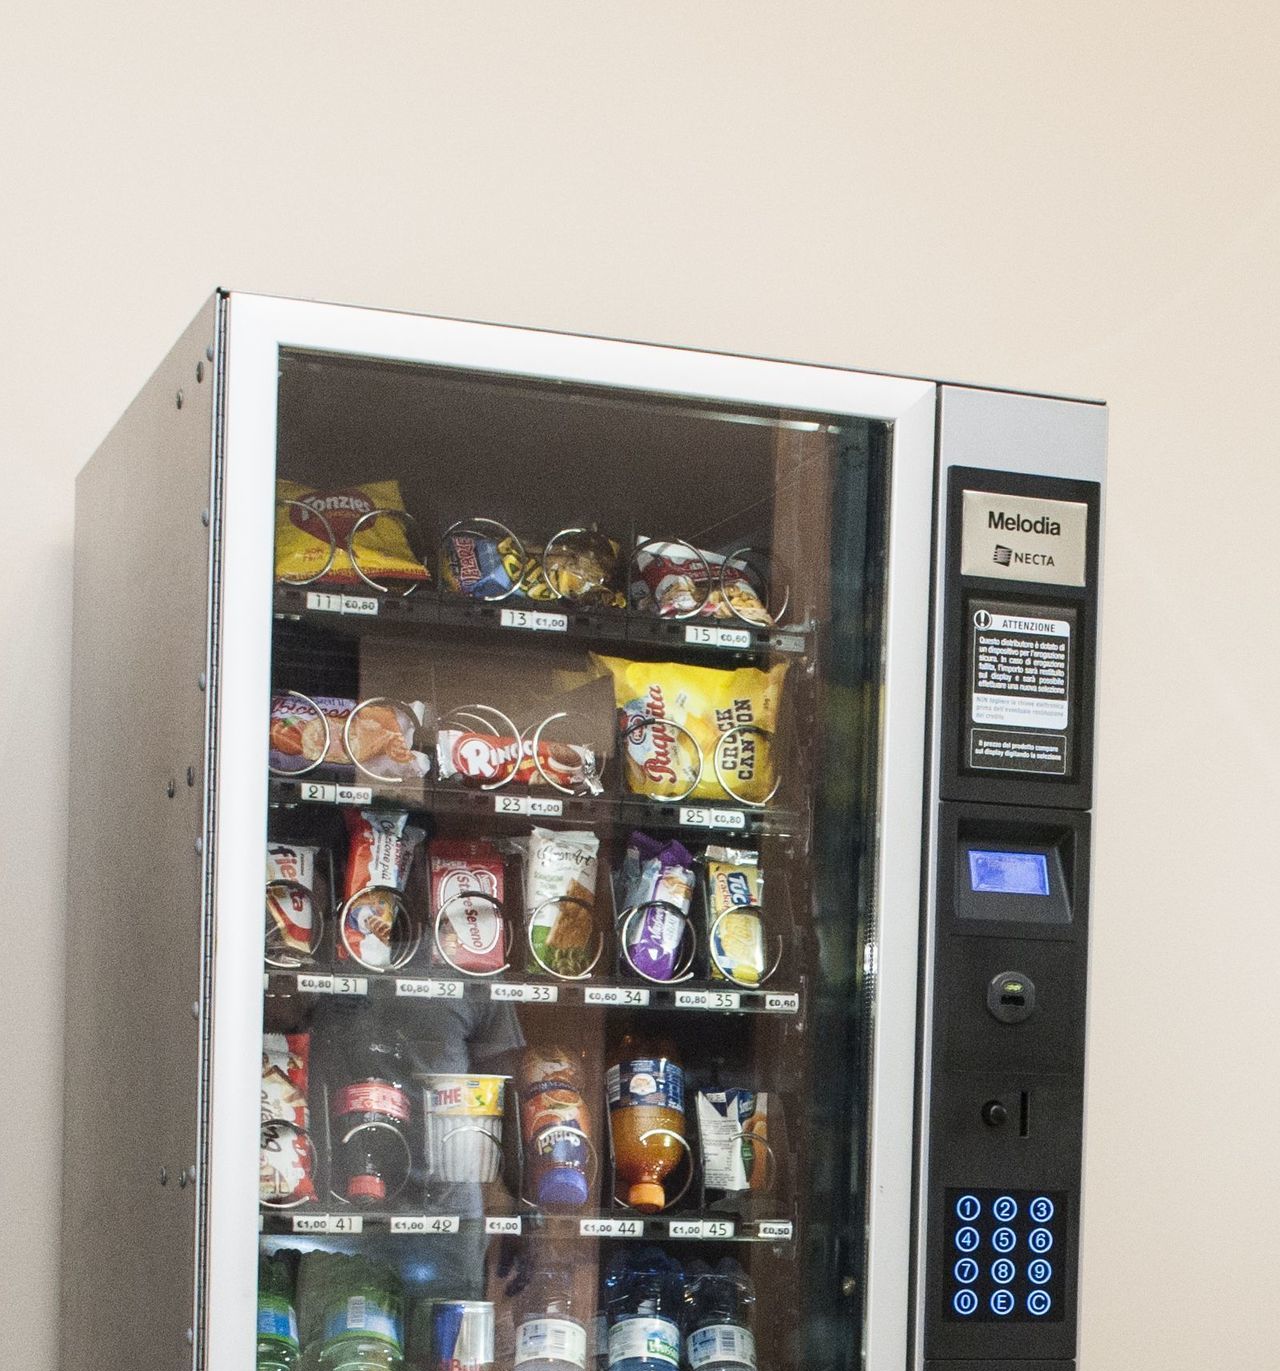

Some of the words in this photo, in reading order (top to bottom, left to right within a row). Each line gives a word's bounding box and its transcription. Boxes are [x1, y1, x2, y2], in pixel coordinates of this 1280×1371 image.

[987, 511, 1062, 537] Melodia
[1013, 551, 1056, 568] NECTA
[509, 611, 527, 626] 13
[535, 617, 566, 628] €1,00
[1002, 620, 1056, 633] ATTENZIONE
[692, 628, 712, 642] 15
[308, 785, 326, 799] 21
[501, 798, 521, 812] 23
[530, 802, 560, 813] €1,00
[686, 809, 705, 823] 25
[340, 978, 360, 993] 31
[436, 982, 458, 997] 32
[494, 988, 524, 998] €1,00
[530, 986, 551, 1001] 33
[623, 990, 643, 1004] 34
[714, 994, 734, 1008] 35
[437, 1087, 462, 1105] THE
[963, 1200, 971, 1216] 1
[999, 1201, 1011, 1217] 2
[1036, 1202, 1047, 1218] 3
[296, 1220, 328, 1230] €1,00
[335, 1217, 353, 1231] 41
[431, 1219, 453, 1233] 42
[488, 1221, 519, 1231] €1,00
[617, 1222, 637, 1235] 44
[708, 1223, 728, 1236] 45
[960, 1231, 972, 1247] 4
[998, 1232, 1010, 1248] 5
[1035, 1233, 1047, 1248] 6
[961, 1263, 972, 1278] 7
[998, 1264, 1009, 1279] 8
[1034, 1264, 1046, 1279] 9
[960, 1295, 971, 1310] 0
[997, 1295, 1008, 1310] E
[1032, 1295, 1045, 1310] C
